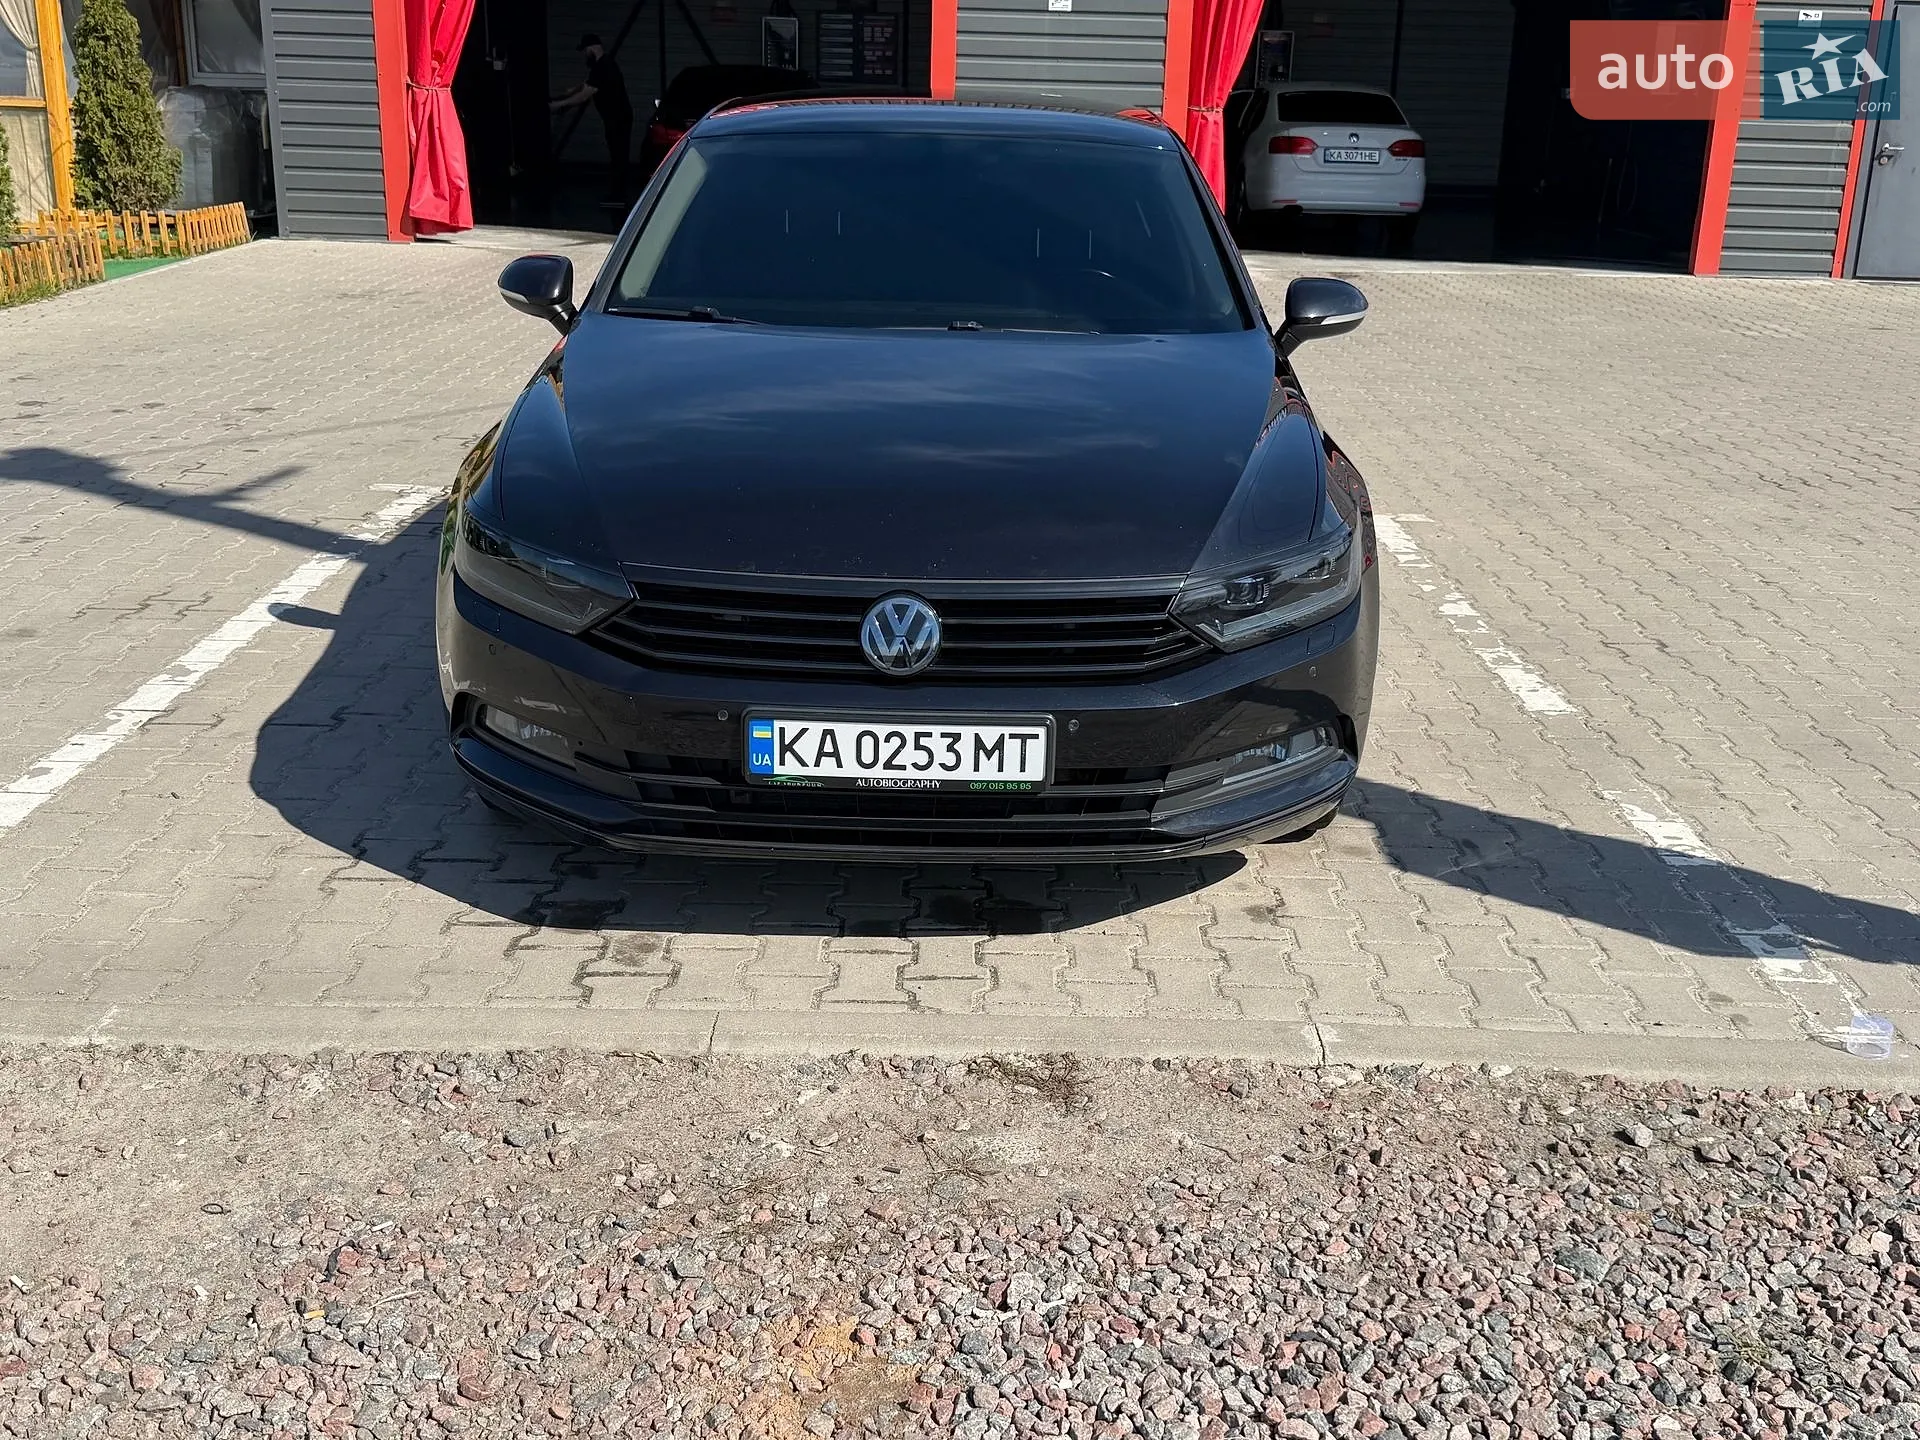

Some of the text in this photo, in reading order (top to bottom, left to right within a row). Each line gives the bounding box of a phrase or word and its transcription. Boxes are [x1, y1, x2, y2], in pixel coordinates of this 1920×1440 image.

[1329, 151, 1377, 161] KA 3071 HE
[778, 726, 1039, 773] KA 0253 MT
[753, 752, 771, 766] UA
[855, 777, 942, 790] AUTOBIOGRAPHY
[969, 782, 1032, 790] 097 015 95 95
